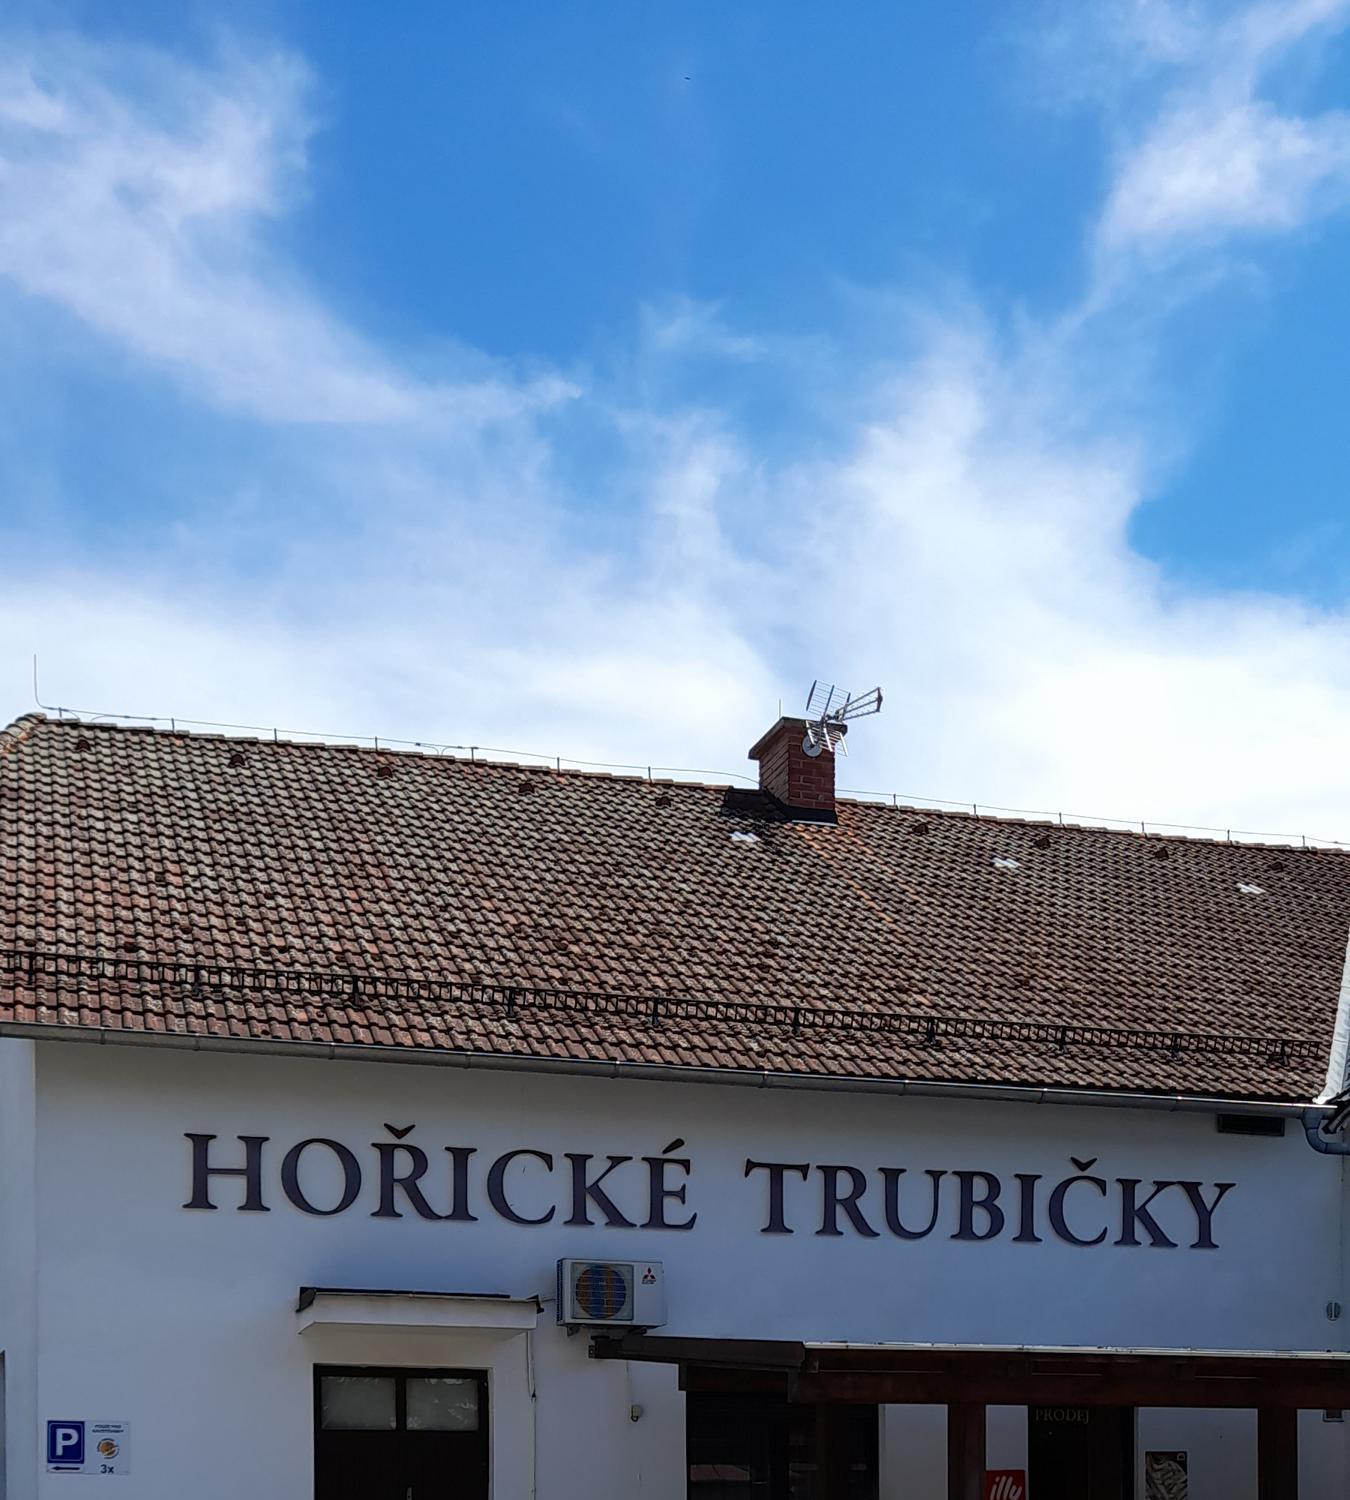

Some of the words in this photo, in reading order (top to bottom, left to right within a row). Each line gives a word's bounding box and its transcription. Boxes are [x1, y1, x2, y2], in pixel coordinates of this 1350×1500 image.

[182, 1122, 698, 1231] HOŘICKÉ
[744, 1156, 1237, 1249] TRUBIČKY
[1035, 1408, 1089, 1424] PRODEJ
[56, 1428, 79, 1456] P
[100, 1464, 115, 1474] 3x
